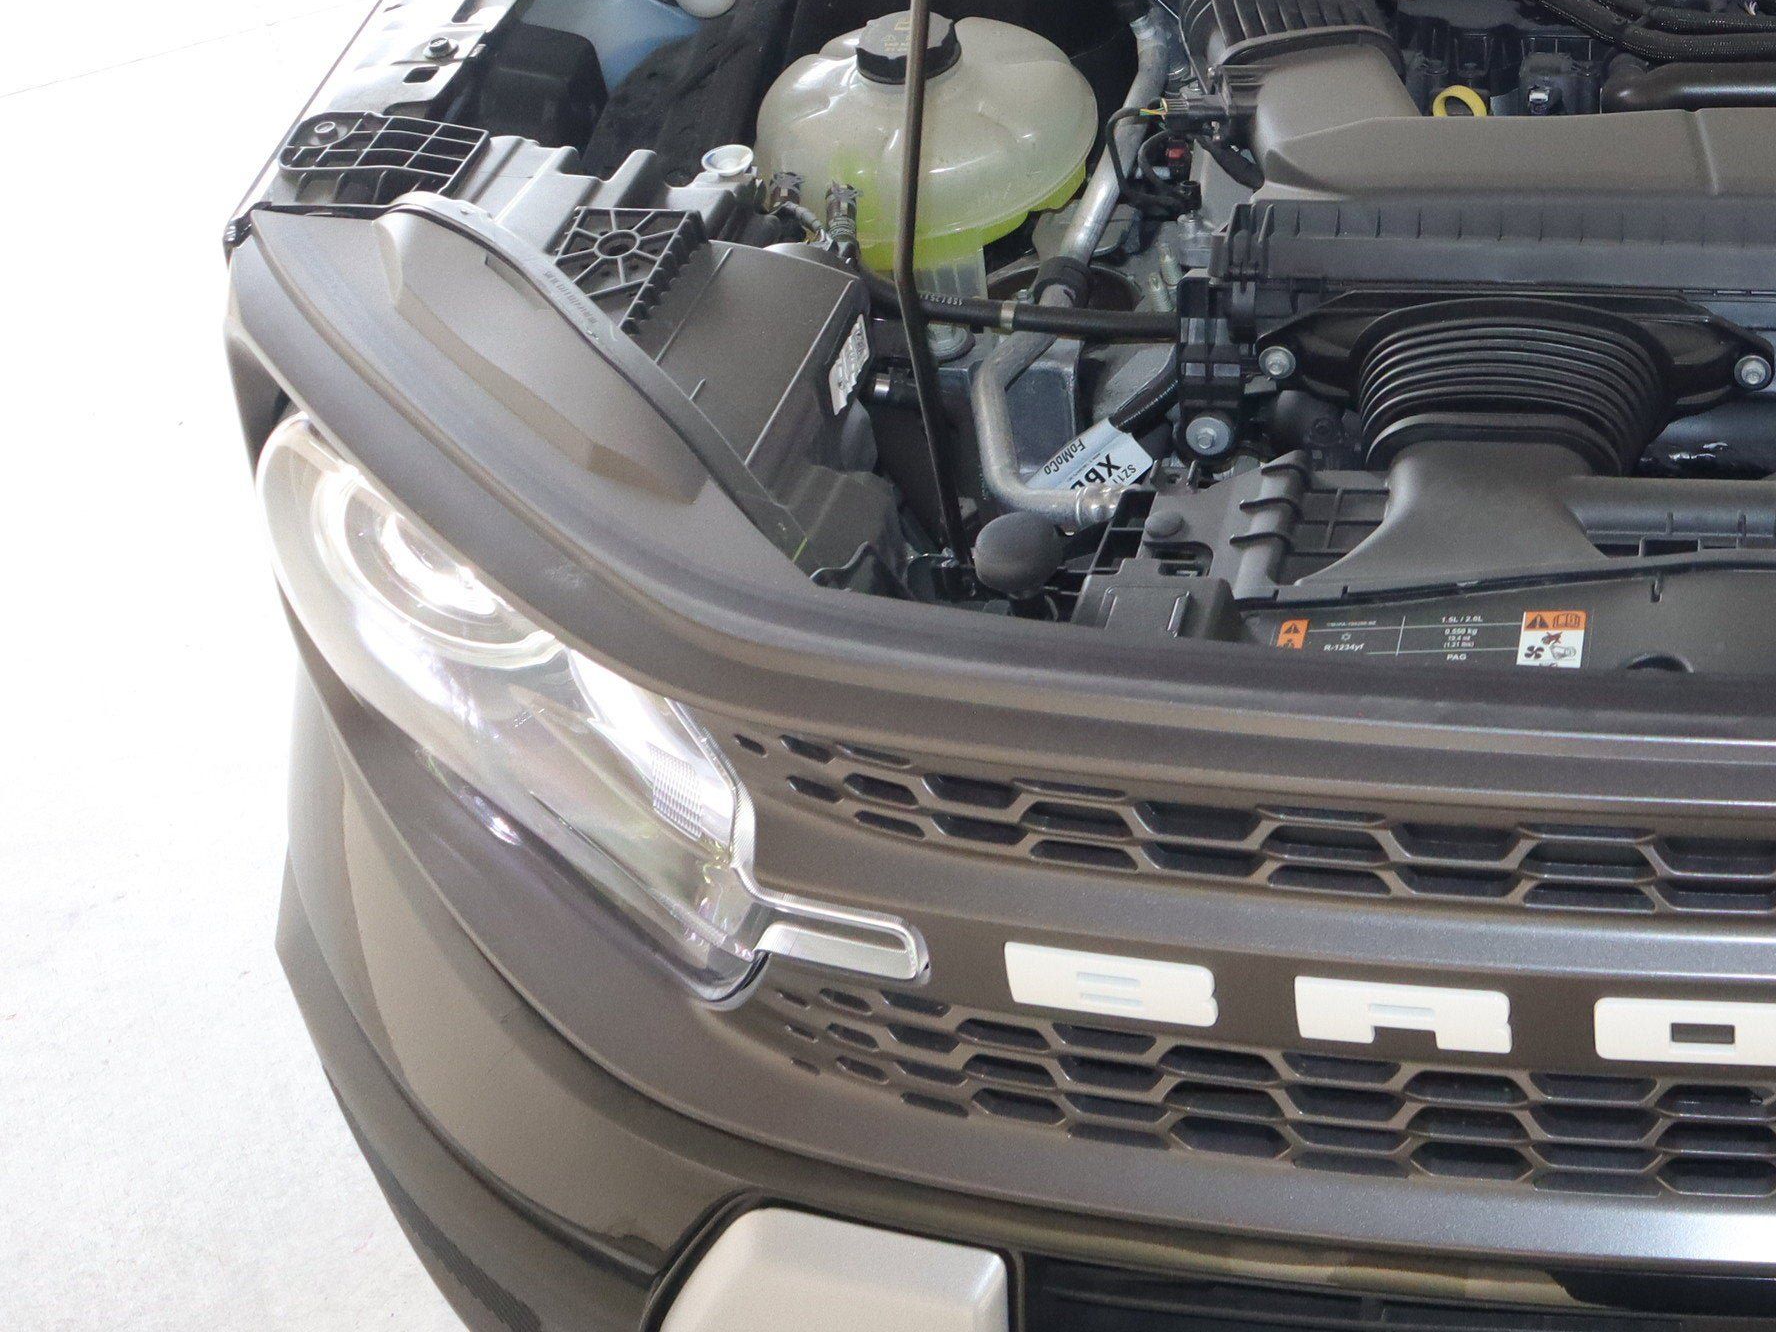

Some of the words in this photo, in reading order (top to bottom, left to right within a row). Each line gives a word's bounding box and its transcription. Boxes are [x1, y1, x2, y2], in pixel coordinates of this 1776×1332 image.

[1044, 438, 1086, 475] FoMoCo
[1323, 642, 1365, 652] R-1234yf
[1446, 653, 1467, 661] PAG
